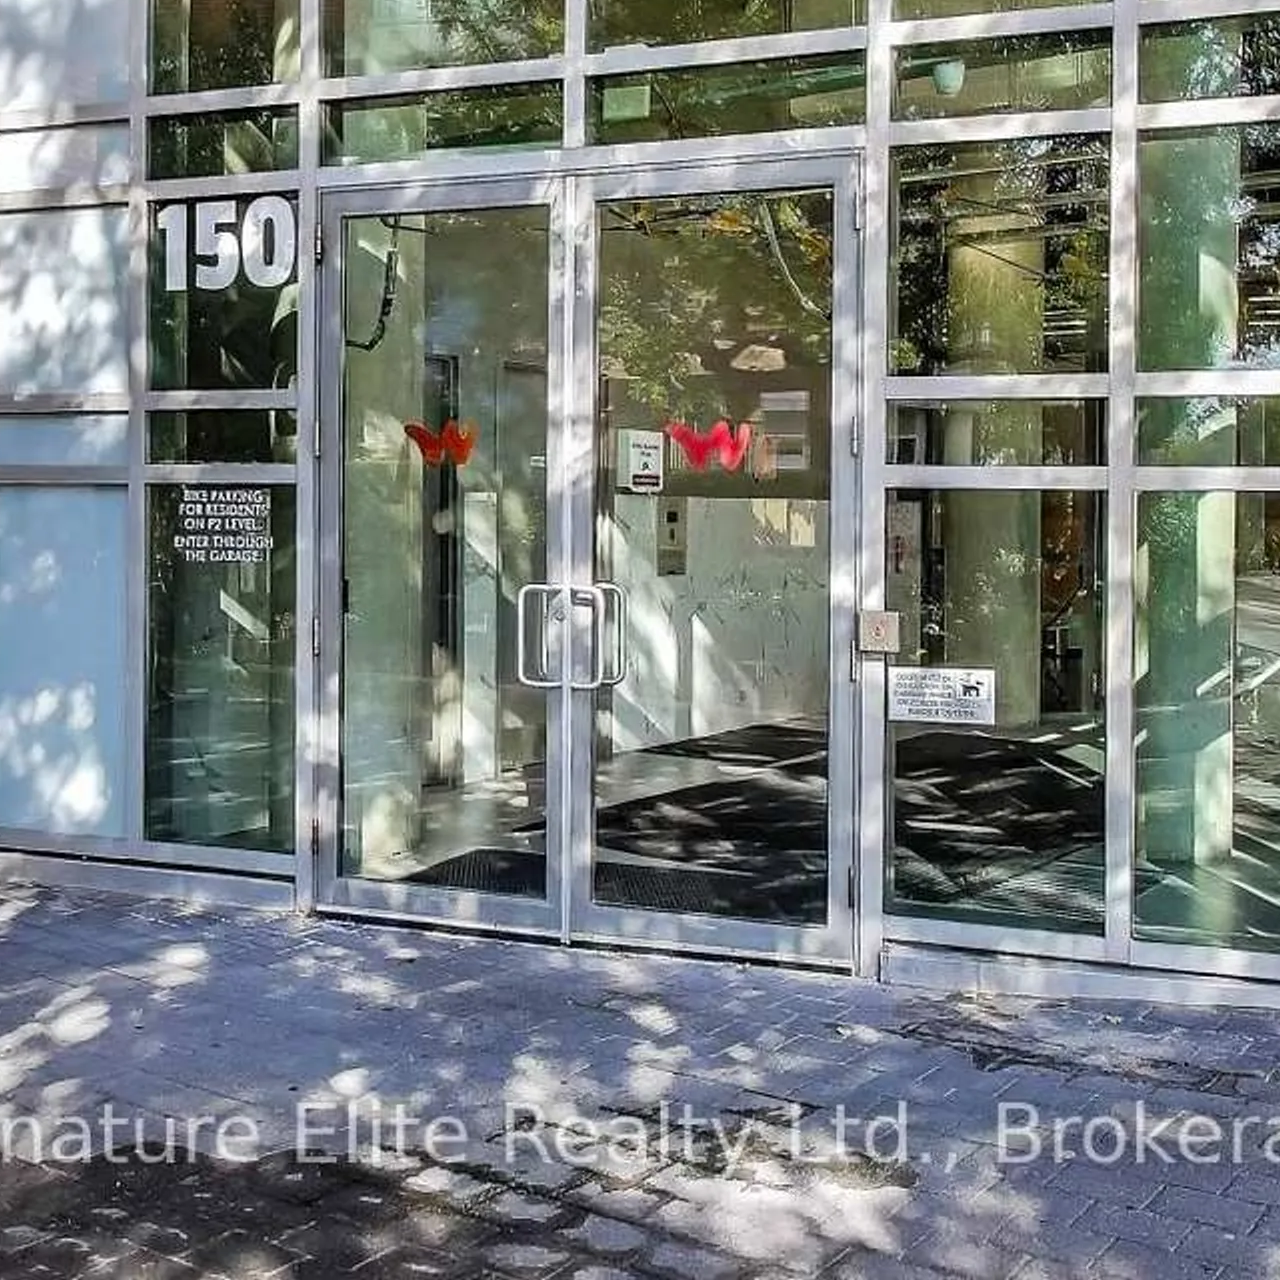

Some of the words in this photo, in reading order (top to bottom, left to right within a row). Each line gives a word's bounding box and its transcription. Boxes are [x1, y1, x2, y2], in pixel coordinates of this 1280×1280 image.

[157, 196, 295, 291] 150
[183, 489, 208, 502] BIKE
[210, 489, 263, 503] PARKING
[178, 503, 203, 515] FOR
[205, 503, 269, 517] RESIDENTS
[184, 517, 205, 530] ON
[207, 517, 222, 531] P2
[174, 535, 210, 548] ENTER
[212, 535, 274, 549] THROUGH
[184, 549, 206, 562] THE
